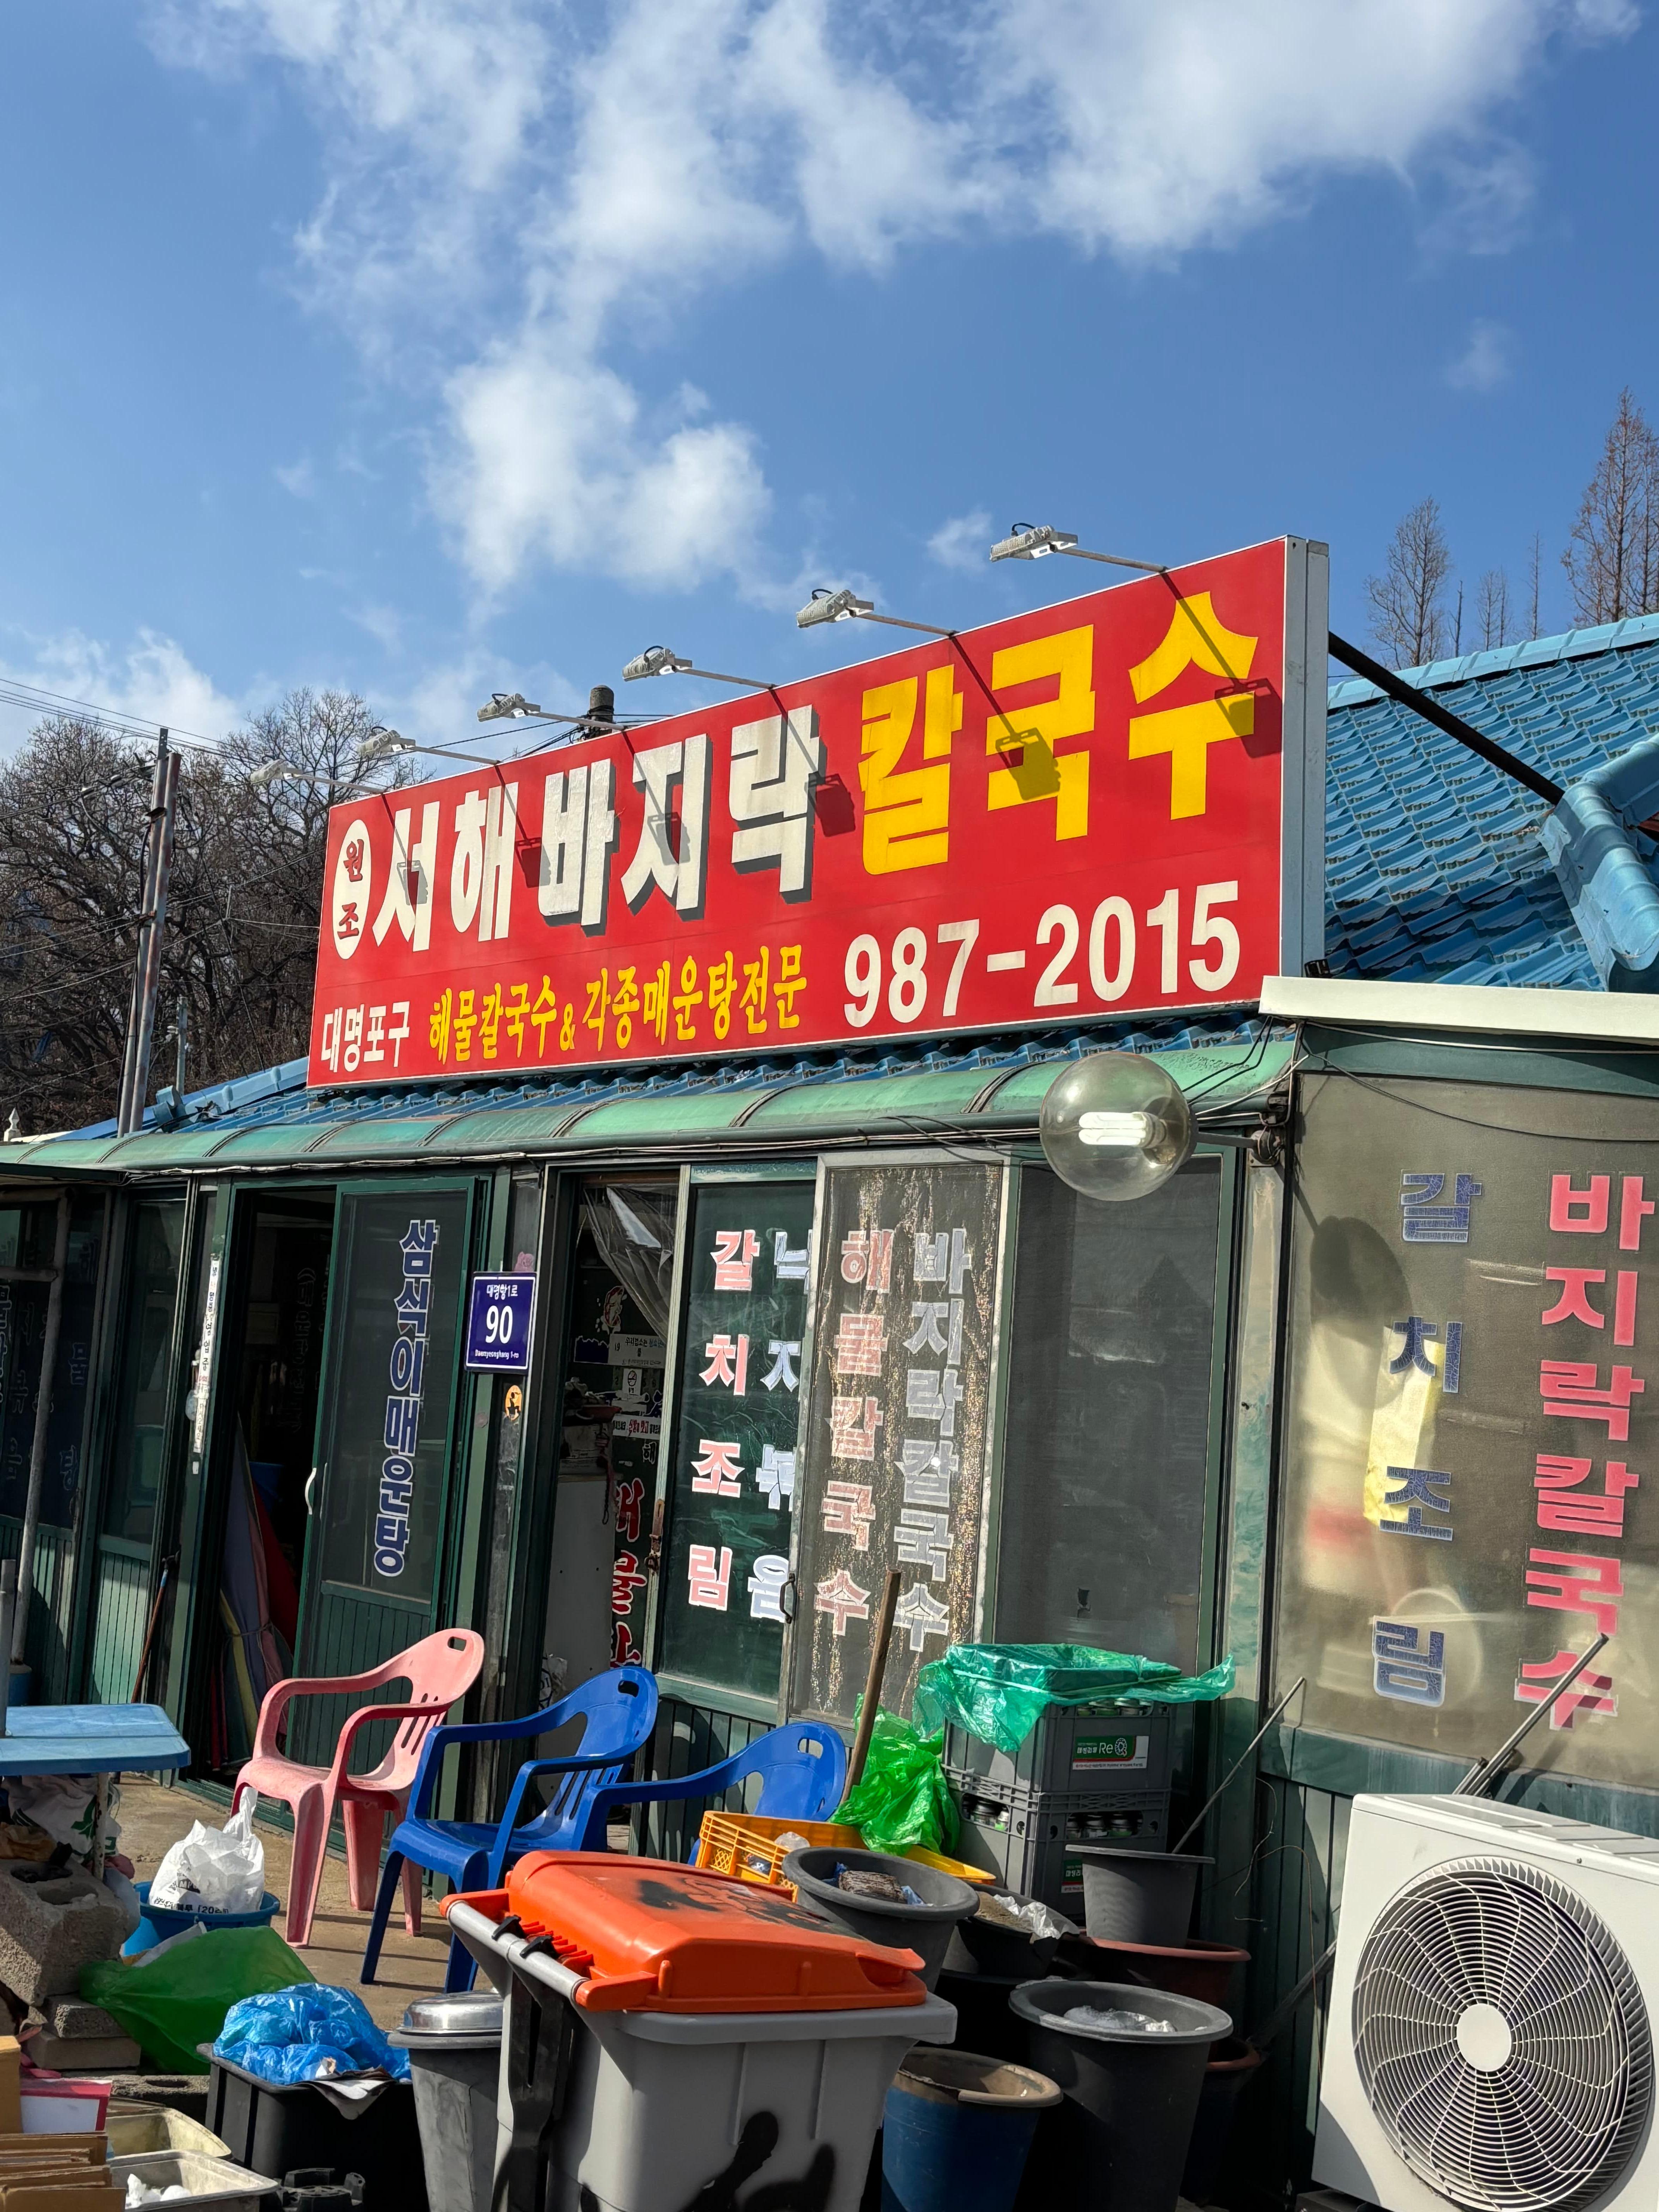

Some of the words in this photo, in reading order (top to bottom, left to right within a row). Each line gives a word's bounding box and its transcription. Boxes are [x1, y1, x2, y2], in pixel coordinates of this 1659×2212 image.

[857, 591, 1258, 874] 칼국수
[337, 839, 364, 940] 원조
[843, 880, 1240, 1028] 987-2015
[321, 1001, 410, 1073] 대명포구
[374, 1219, 438, 1577] 삼식이매운탕
[485, 1305, 513, 1343] 90
[894, 1228, 972, 1652] 바지락칼국수
[1515, 1173, 1655, 1730] 바지락칼국수
